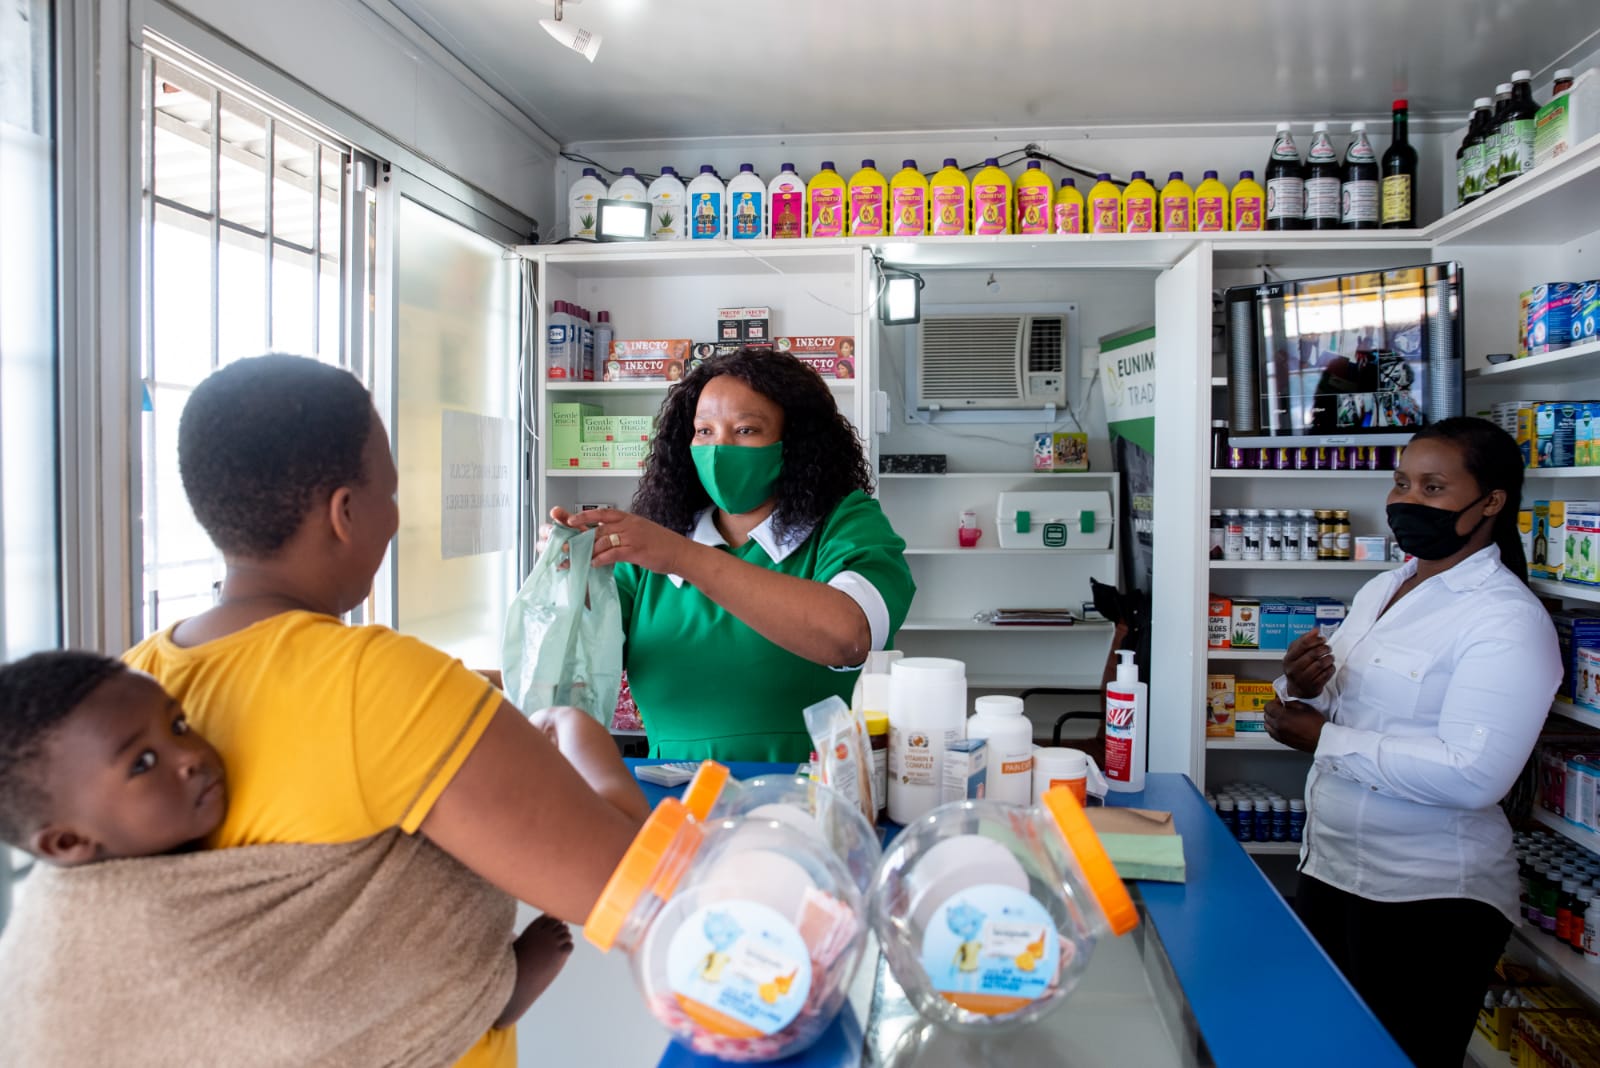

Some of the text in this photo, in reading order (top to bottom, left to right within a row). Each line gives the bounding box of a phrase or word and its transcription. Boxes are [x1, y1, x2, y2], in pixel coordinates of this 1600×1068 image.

[631, 341, 669, 350] INECTO
[795, 337, 835, 347] INECTO
[624, 360, 664, 370] INECTO
[585, 418, 614, 426] Gentle
[580, 444, 609, 452] Gentle
[616, 444, 645, 452] Gentle
